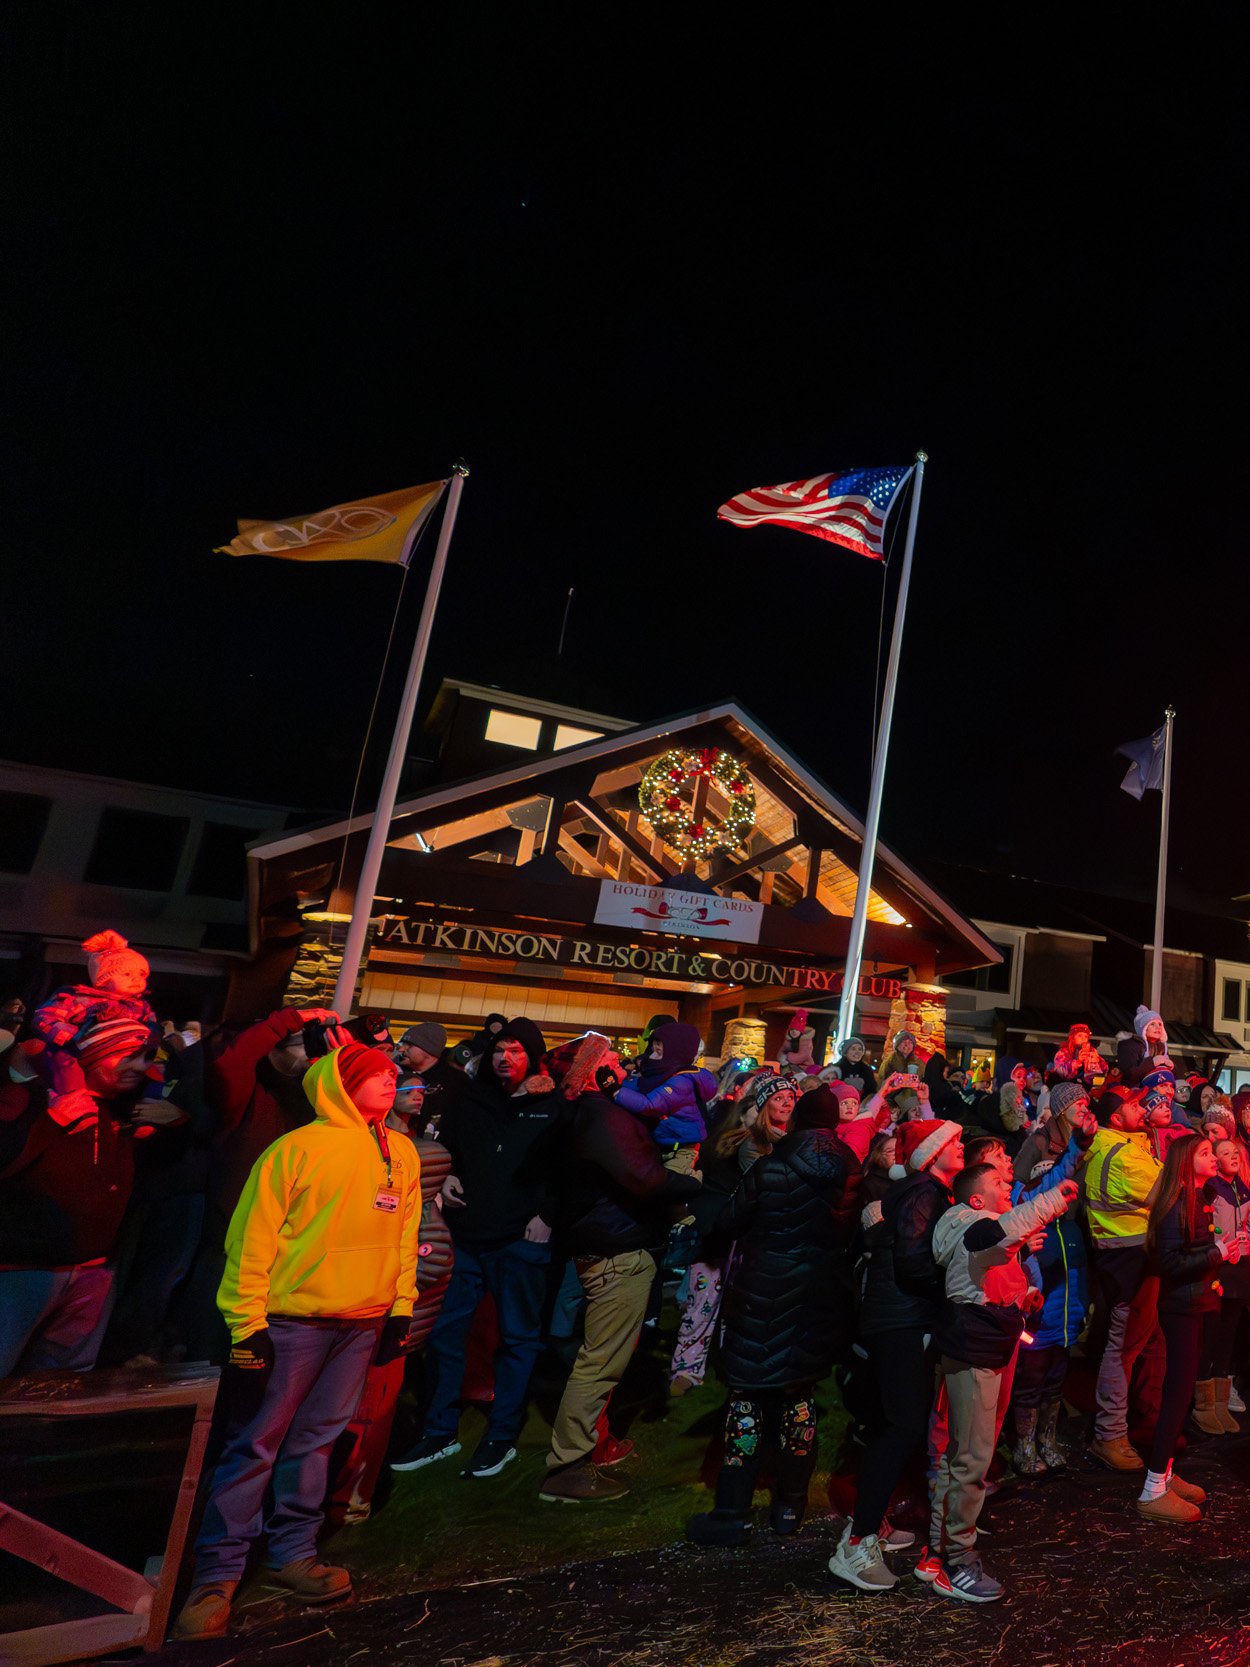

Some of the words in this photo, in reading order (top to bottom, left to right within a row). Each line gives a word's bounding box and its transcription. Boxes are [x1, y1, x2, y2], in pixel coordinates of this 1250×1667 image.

[713, 900, 754, 912] CARDS
[386, 920, 563, 960] ATKINSON
[570, 941, 686, 974] RESORT
[688, 956, 706, 976] &
[711, 959, 836, 991] COUNTRY
